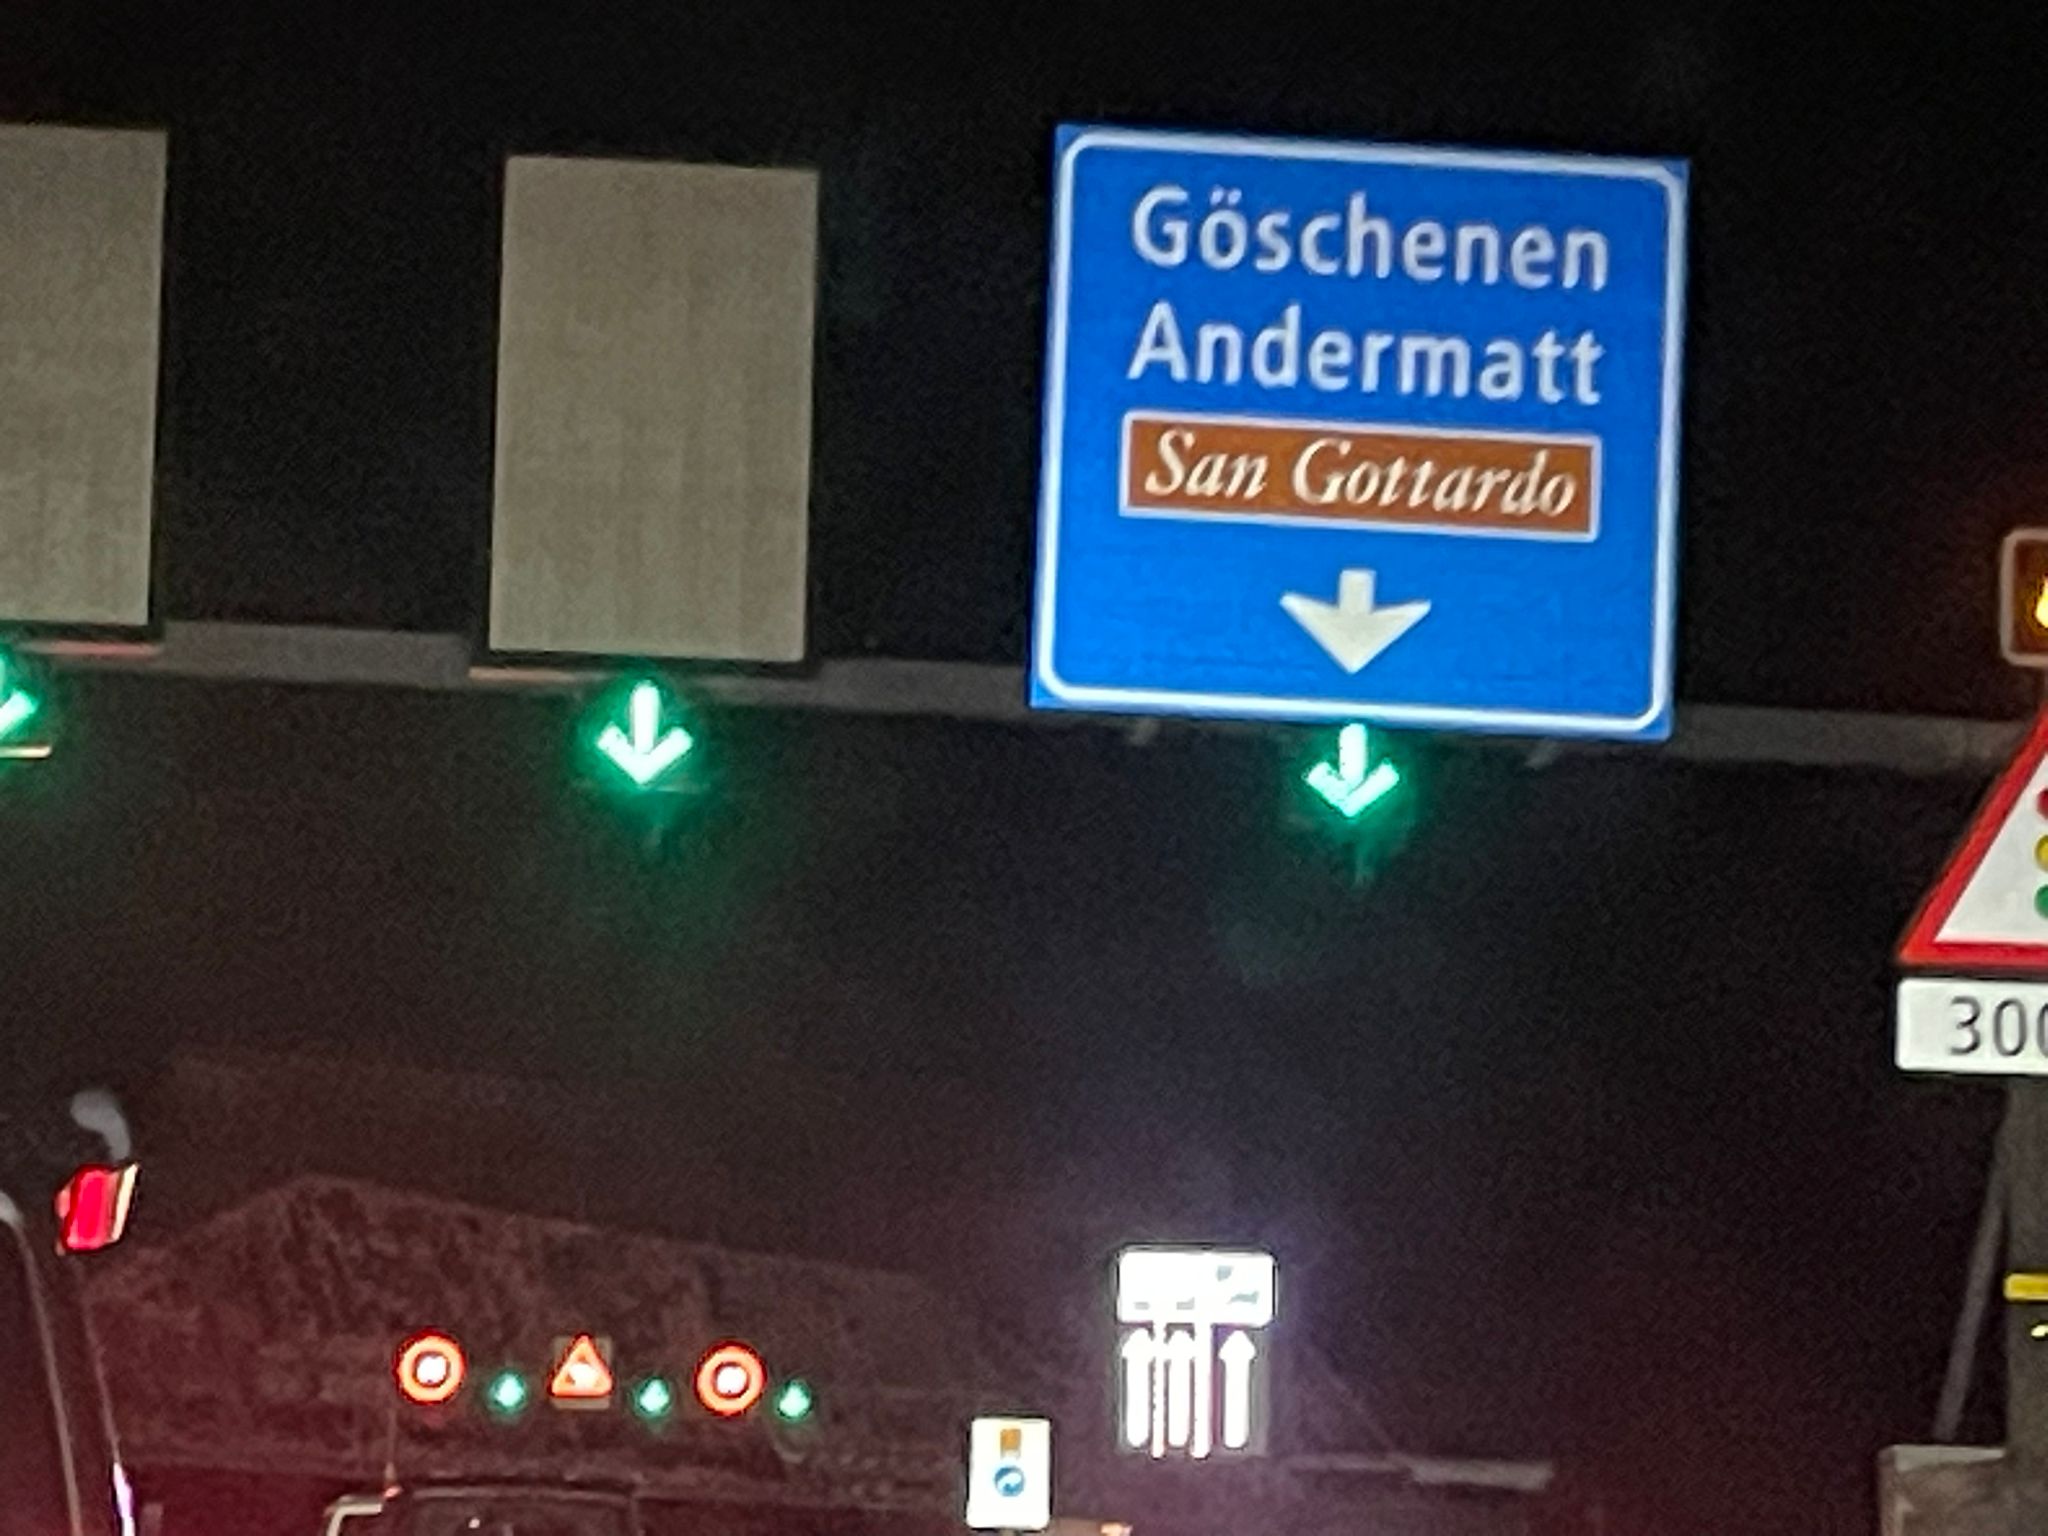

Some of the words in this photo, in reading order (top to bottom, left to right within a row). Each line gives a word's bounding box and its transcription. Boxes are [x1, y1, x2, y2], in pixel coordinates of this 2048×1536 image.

[1131, 184, 1609, 291] Göschenen
[1127, 300, 1605, 405] Andermatt
[1145, 429, 1269, 497] San
[1291, 437, 1576, 518] Gottardo
